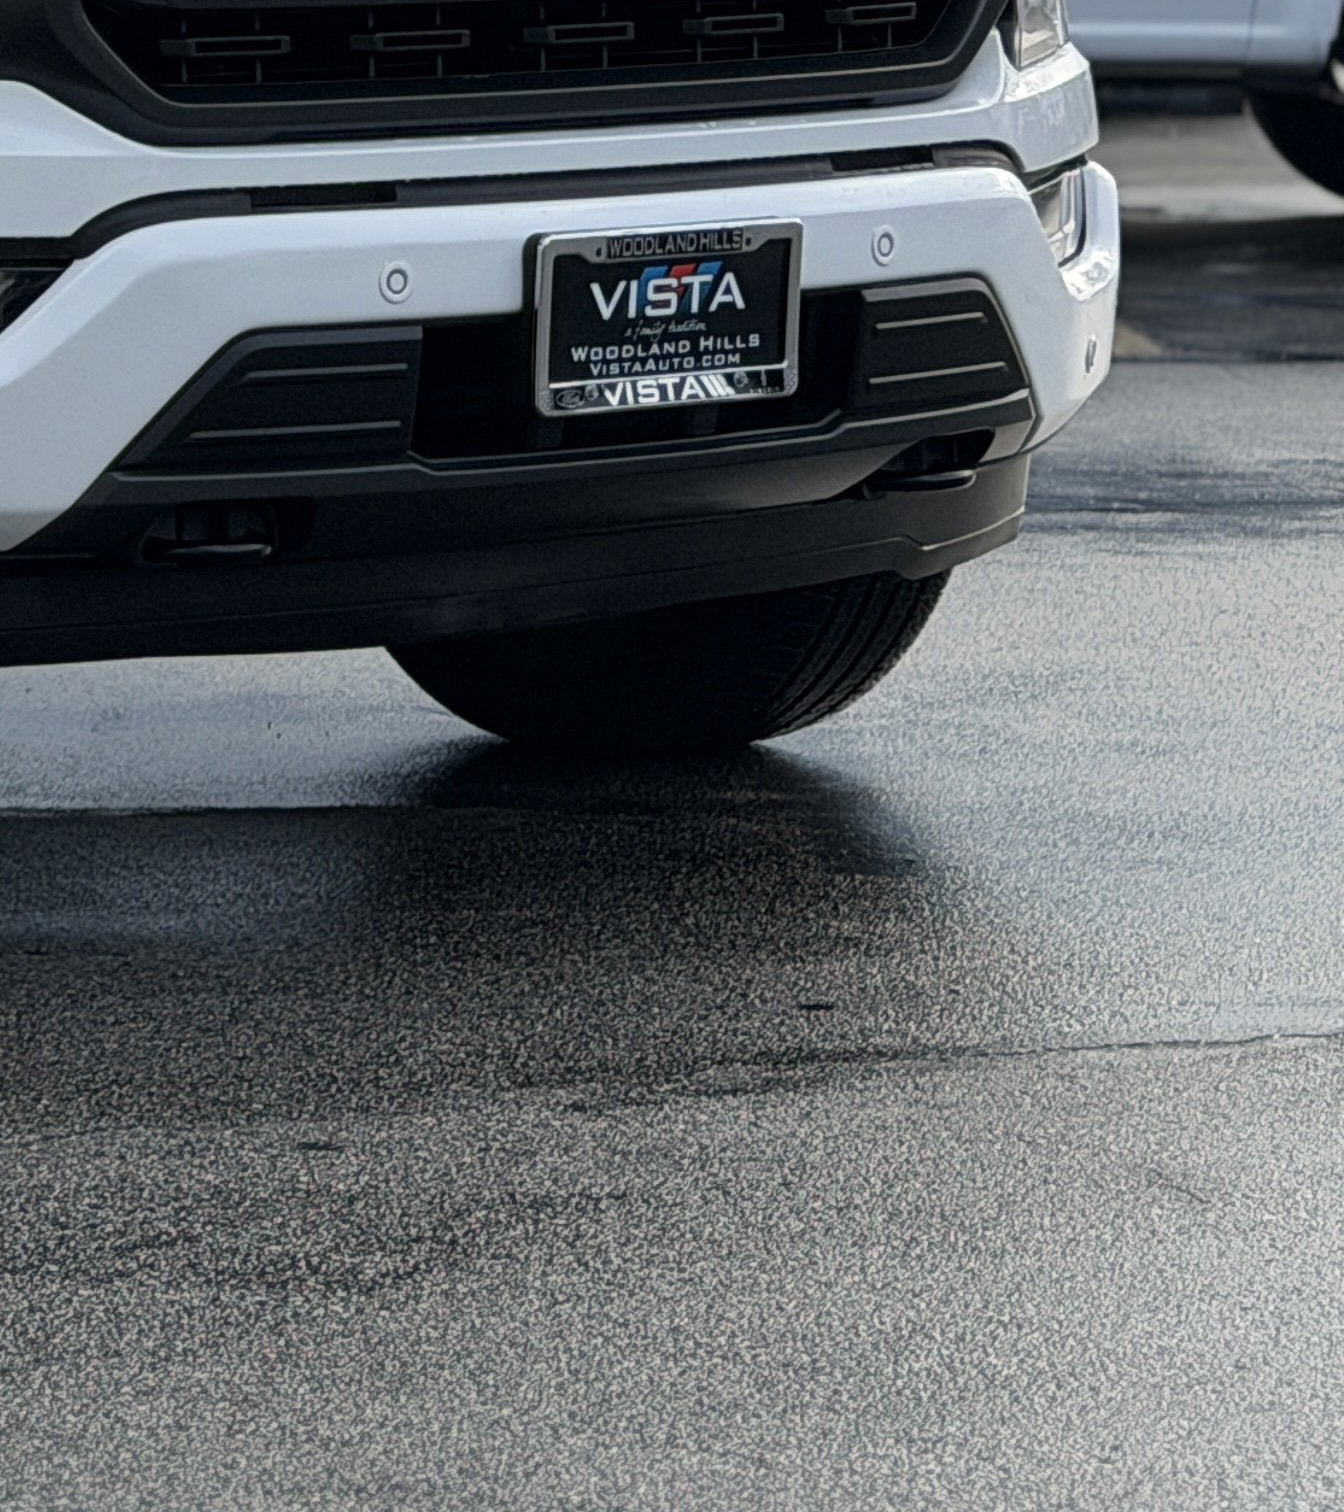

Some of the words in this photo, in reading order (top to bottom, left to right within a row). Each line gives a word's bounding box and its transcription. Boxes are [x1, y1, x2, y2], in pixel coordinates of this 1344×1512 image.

[610, 233, 697, 258] WOODLAND
[699, 230, 743, 252] HILLS
[590, 272, 745, 320] VISTA
[571, 340, 691, 363] WOODLAND
[699, 333, 760, 353] HILLS
[602, 375, 706, 406] VISTA
